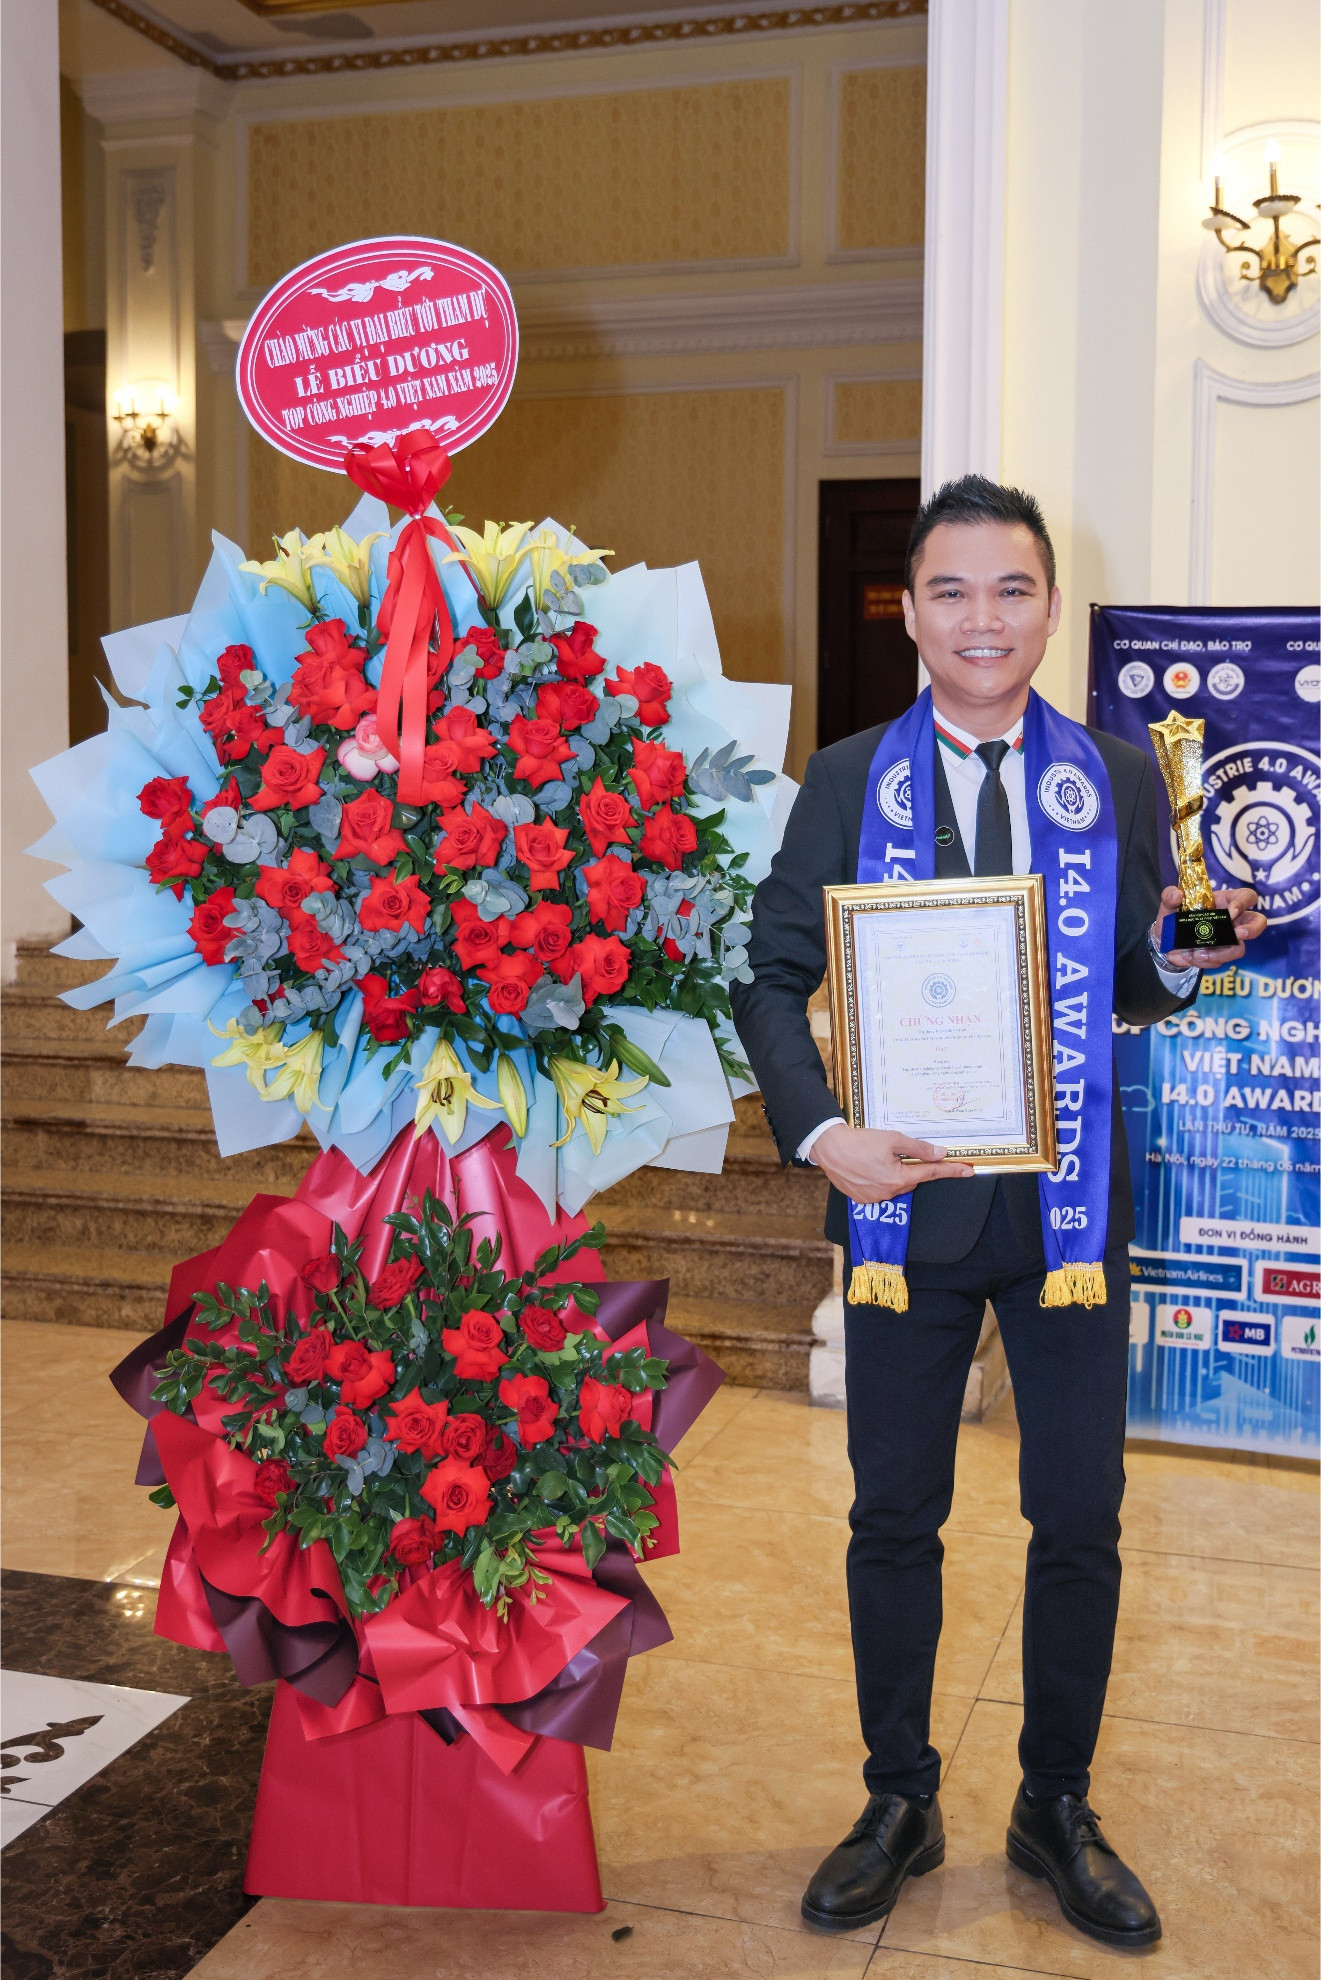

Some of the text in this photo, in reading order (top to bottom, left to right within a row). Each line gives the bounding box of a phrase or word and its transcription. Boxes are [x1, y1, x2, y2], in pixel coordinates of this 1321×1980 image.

[264, 284, 489, 369] CHÀO MỪNG CÁC VỊ ĐẠI BIỂU TỚI THAM DỰ
[294, 338, 470, 398] LỄ BIỂU DƯƠNG
[281, 362, 499, 431] TOP CÔNG NGHIỆP 4.0 VIỆT NAM NĂM 2025
[1113, 639, 1129, 650] CƠ
[1131, 640, 1160, 651] QUAN
[1286, 640, 1303, 651] CƠ
[1257, 756, 1287, 774] 4.0
[1200, 965, 1251, 997] BIỂU
[899, 1013, 982, 1027] CHỨNG NHẬN
[1047, 848, 1091, 1184] I4.0 AWARDS
[1156, 1009, 1251, 1040] CÔNG
[1182, 1046, 1320, 1079] VIỆT NAM
[1161, 1082, 1215, 1107] I4.0
[1221, 1157, 1236, 1167] 22
[852, 1200, 908, 1226] 2025
[1243, 1327, 1266, 1342] MB
